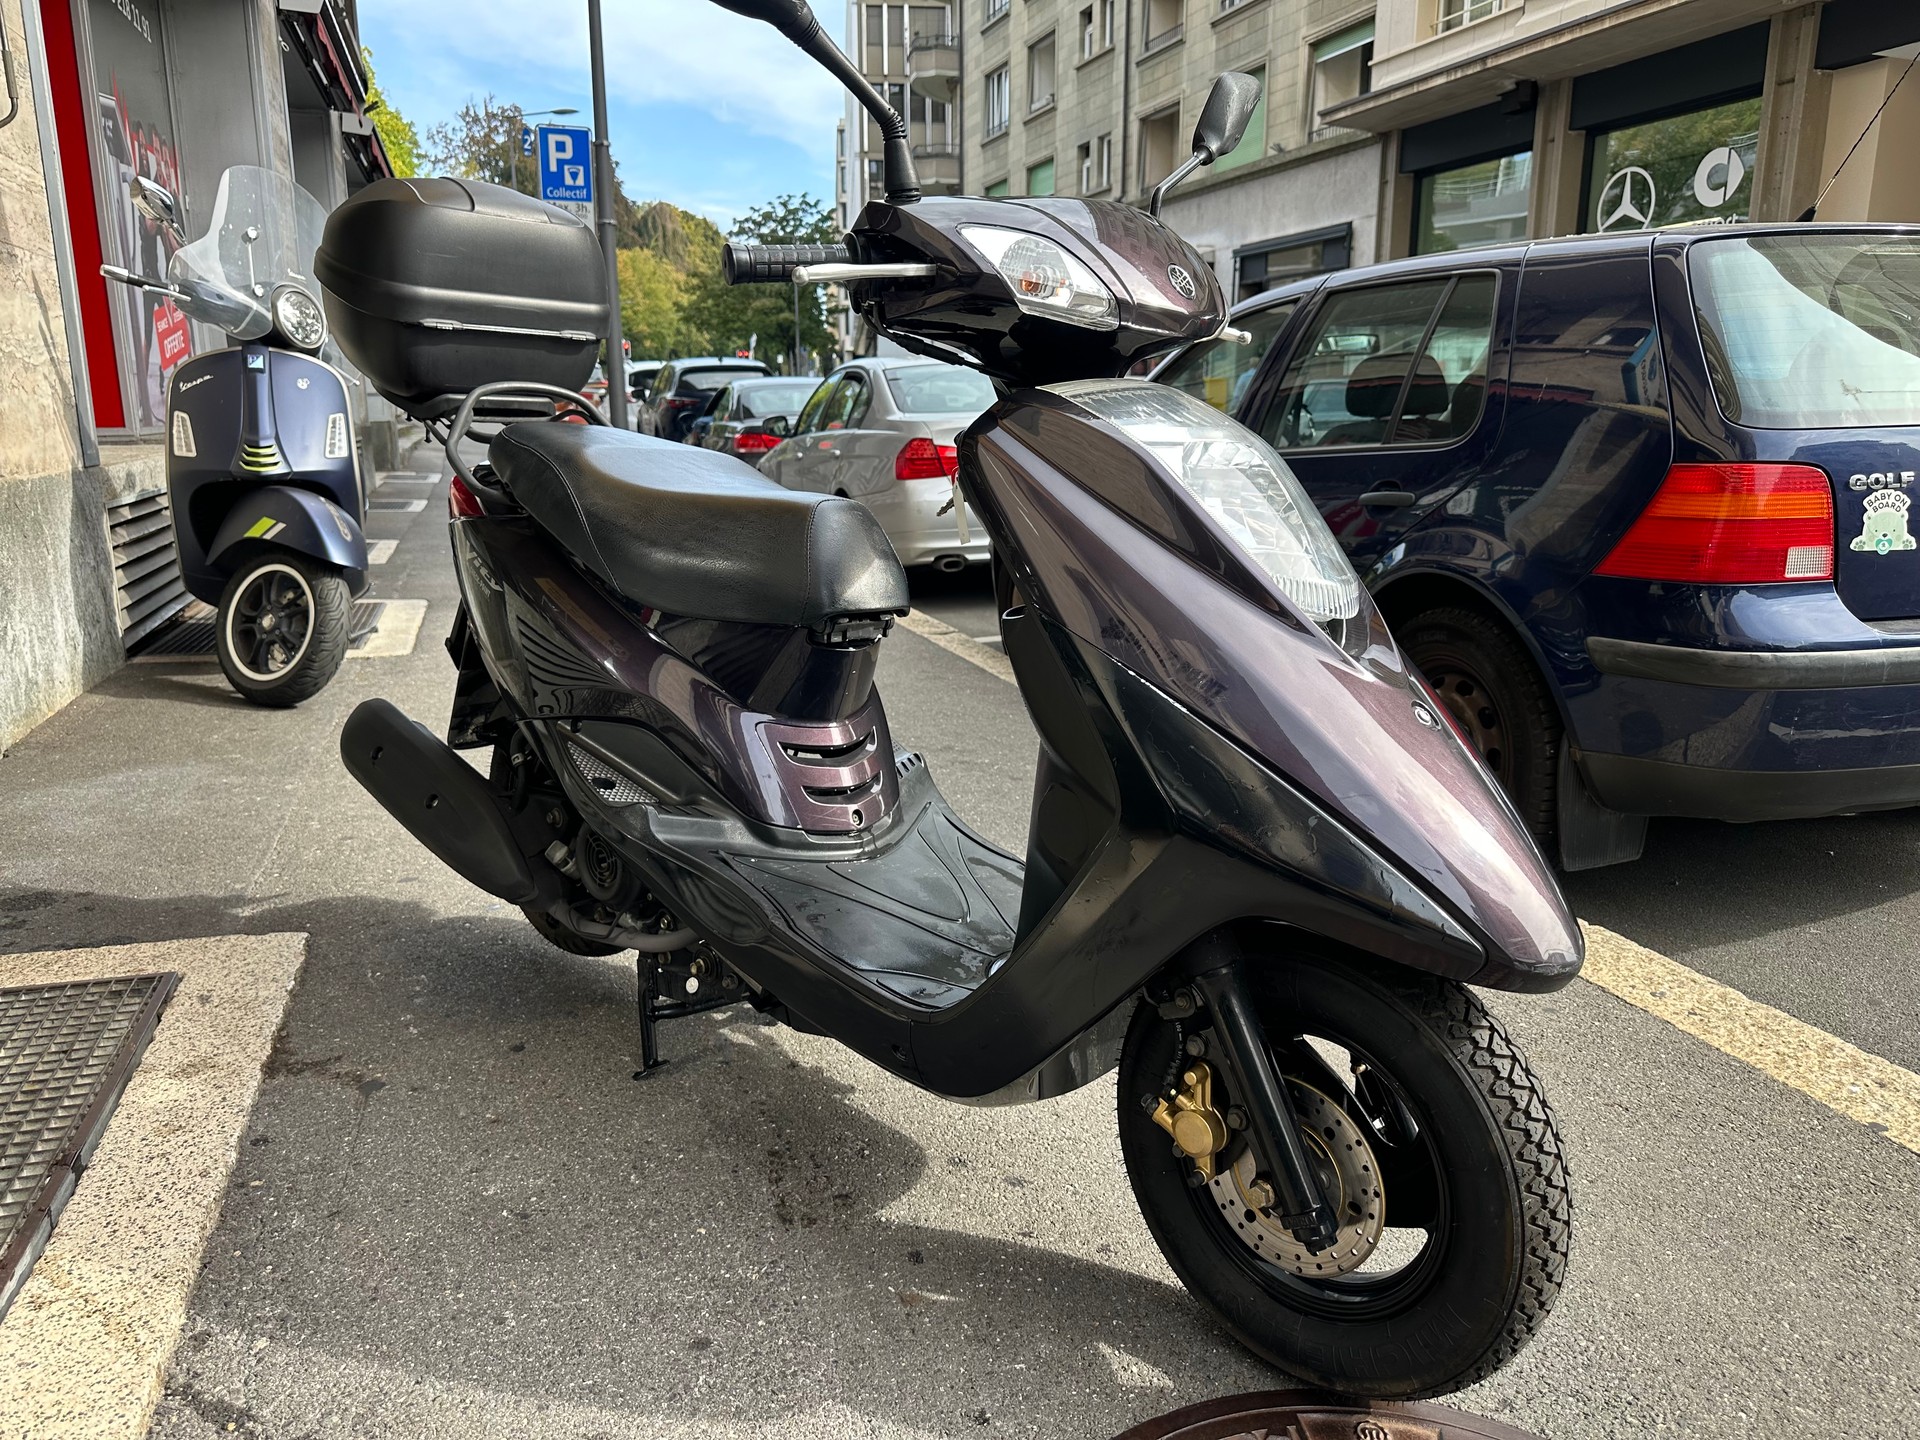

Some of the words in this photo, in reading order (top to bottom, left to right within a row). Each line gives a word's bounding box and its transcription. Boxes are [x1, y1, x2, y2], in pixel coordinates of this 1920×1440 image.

[141, 15, 152, 43] 91
[524, 135, 532, 149] 2
[547, 133, 573, 172] P
[546, 187, 587, 199] Collectif
[1849, 471, 1916, 491] GOLF
[1866, 492, 1893, 507] BABY
[1894, 494, 1908, 507] ON
[1872, 501, 1902, 513] BOARD
